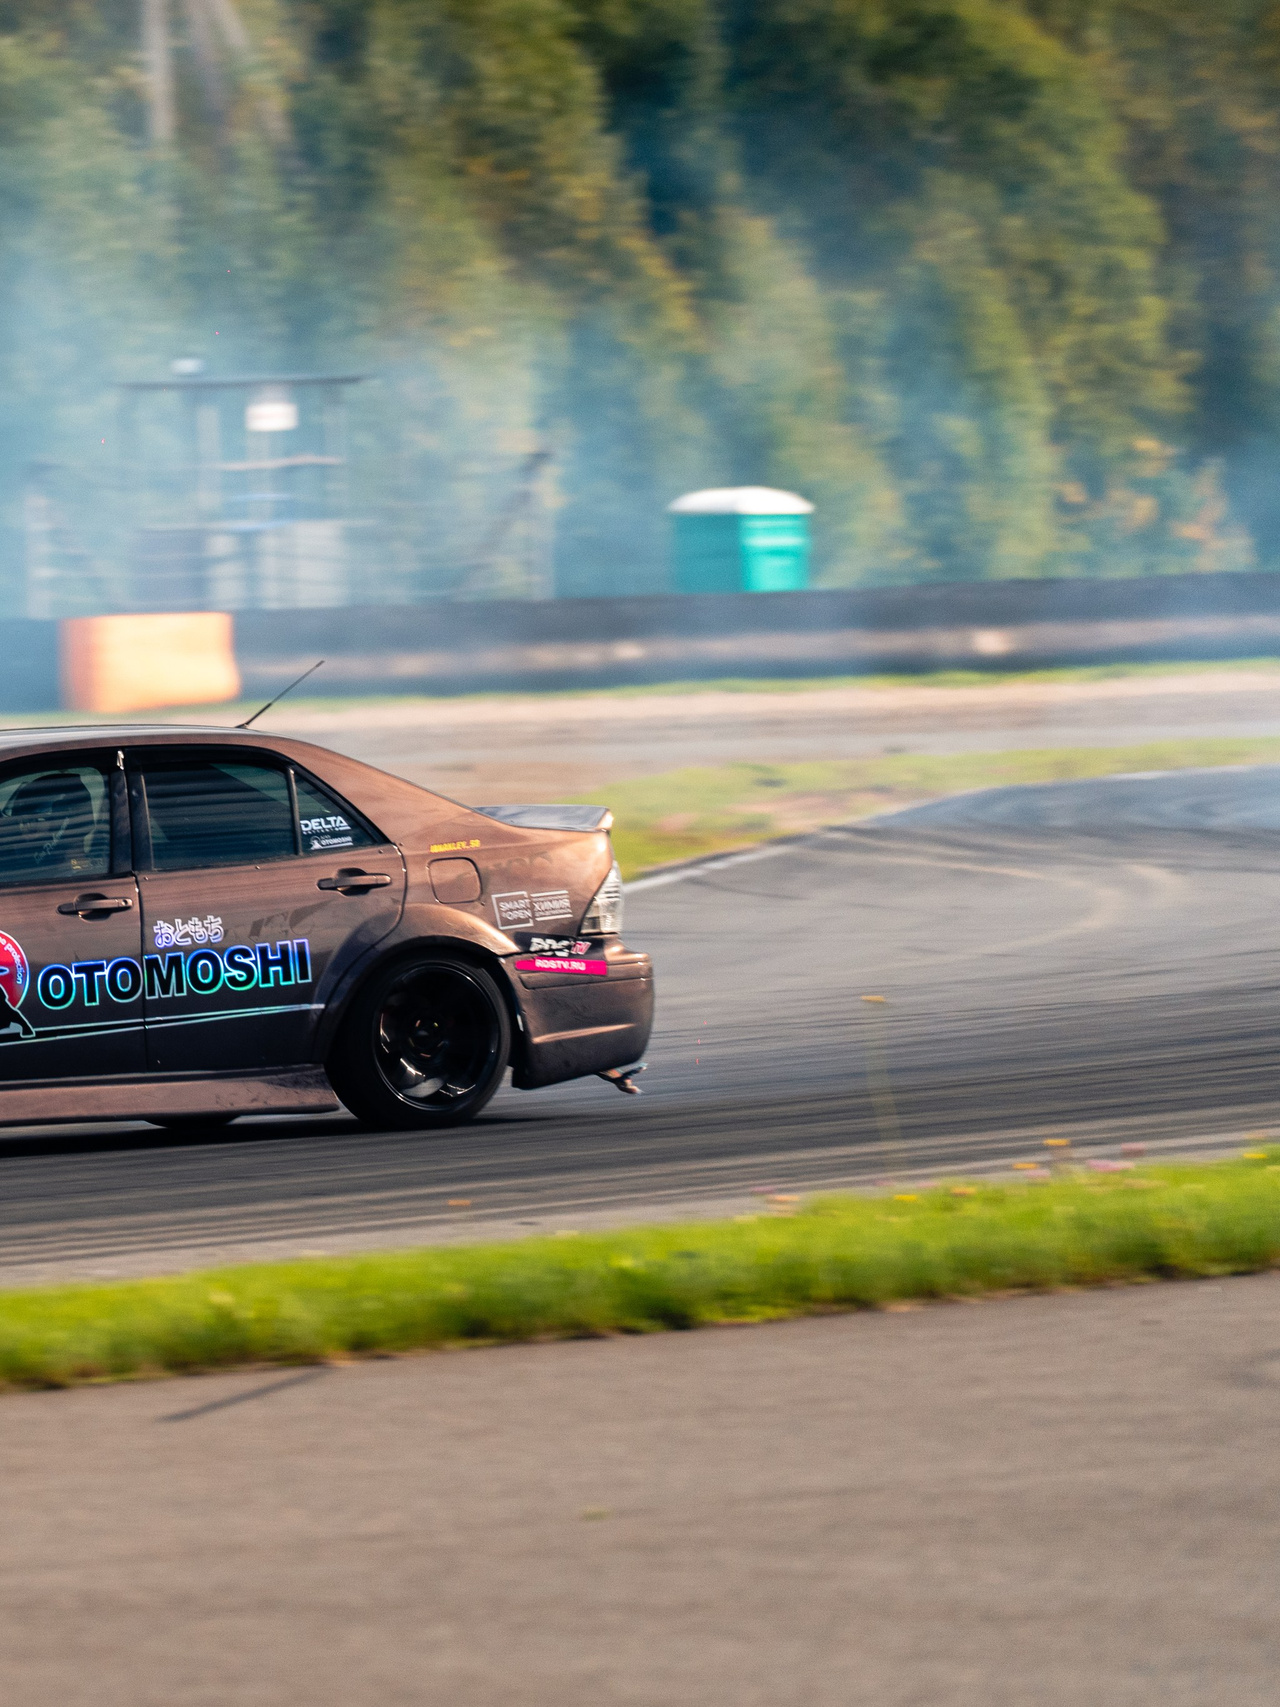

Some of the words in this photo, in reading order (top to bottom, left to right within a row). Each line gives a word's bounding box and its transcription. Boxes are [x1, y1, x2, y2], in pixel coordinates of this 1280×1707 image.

[300, 816, 351, 831] DELTA
[499, 899, 531, 911] SMART
[153, 915, 225, 948] おともち
[4, 943, 25, 984] protection
[37, 938, 313, 1010] OTOMOSHI
[535, 959, 586, 971] RDSTV.RU
